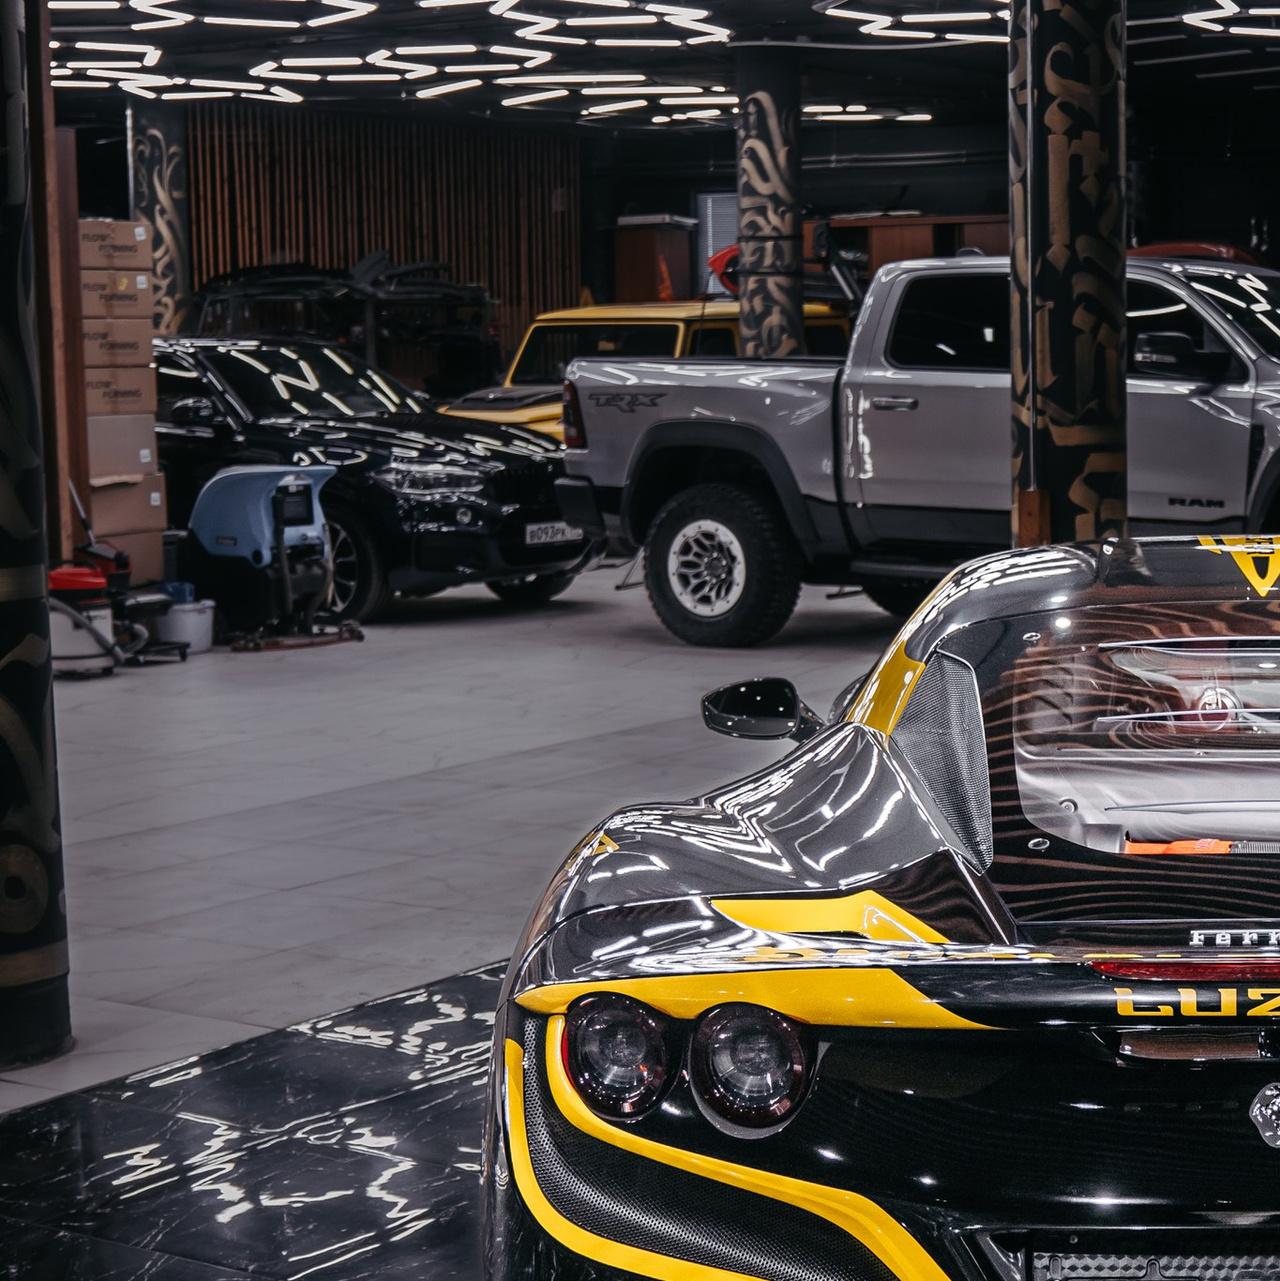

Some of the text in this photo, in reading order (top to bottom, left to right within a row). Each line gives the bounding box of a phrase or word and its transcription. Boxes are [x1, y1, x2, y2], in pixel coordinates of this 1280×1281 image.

[83, 284, 107, 292] FLOW
[83, 332, 109, 340] FLOW
[86, 381, 112, 389] FLOW
[589, 393, 667, 413] TRX
[1168, 497, 1225, 508] RAM
